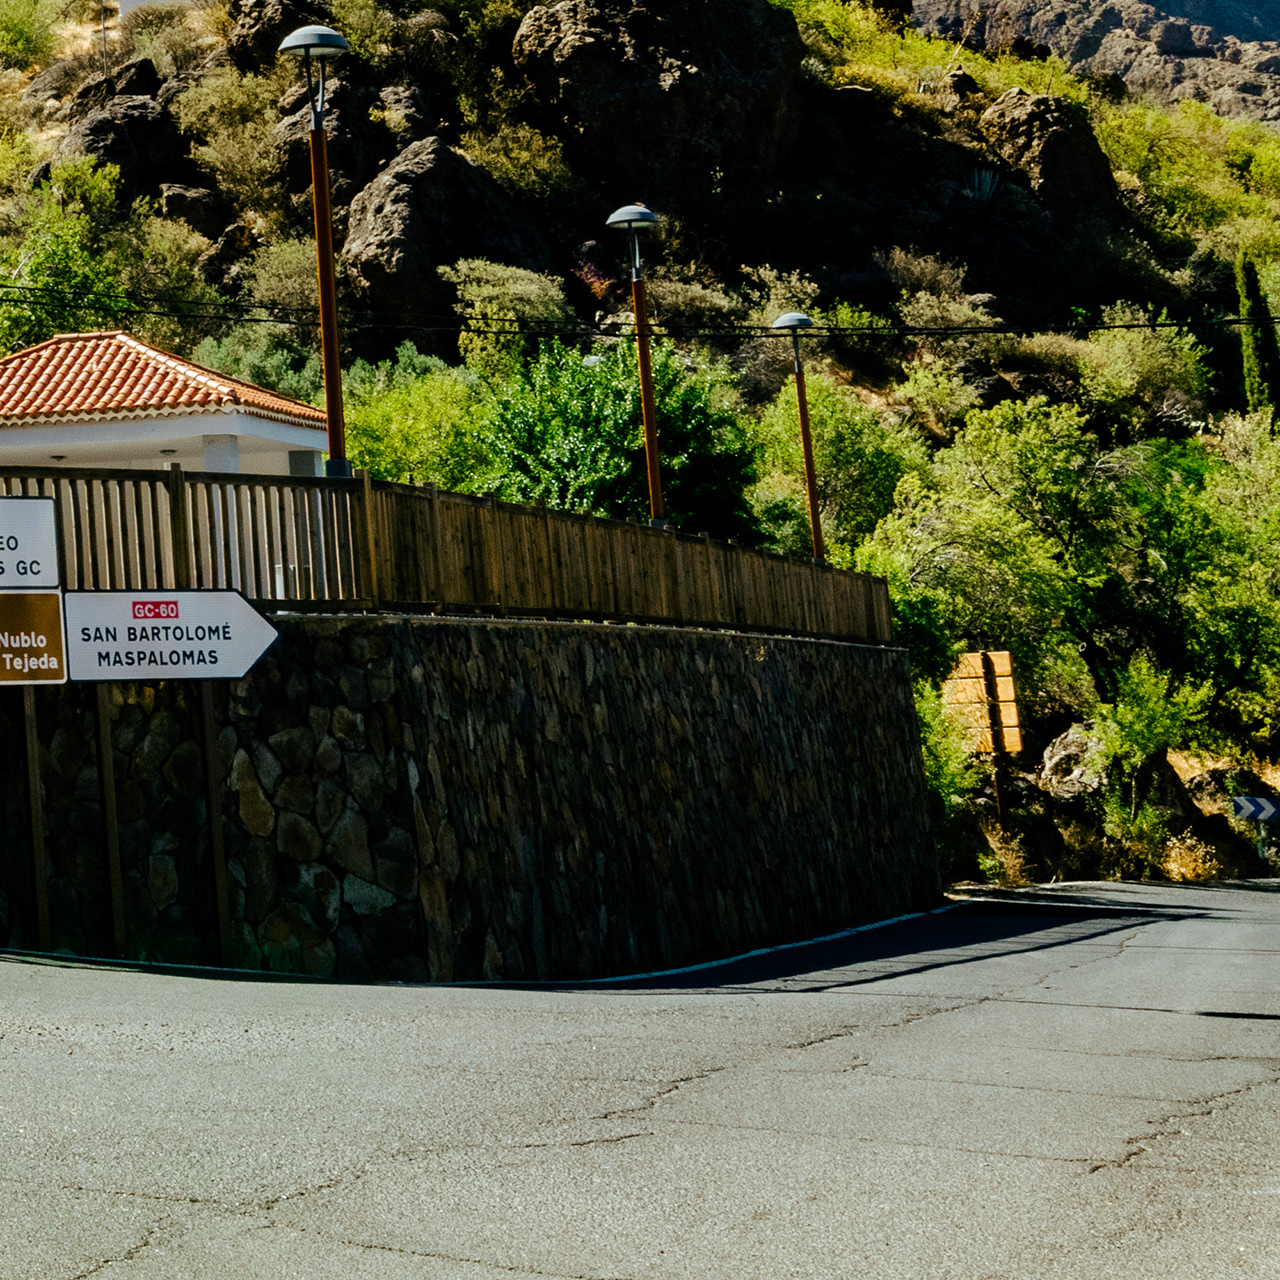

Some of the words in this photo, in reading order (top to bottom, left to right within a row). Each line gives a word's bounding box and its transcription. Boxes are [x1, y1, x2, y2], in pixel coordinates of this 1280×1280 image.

[16, 560, 41, 575] GC
[134, 604, 177, 617] GC-60
[81, 627, 117, 642] SAN
[127, 622, 232, 641] BARTOLOMÉ
[2, 653, 59, 673] Tejeda
[97, 650, 219, 667] MASPALOMAS
